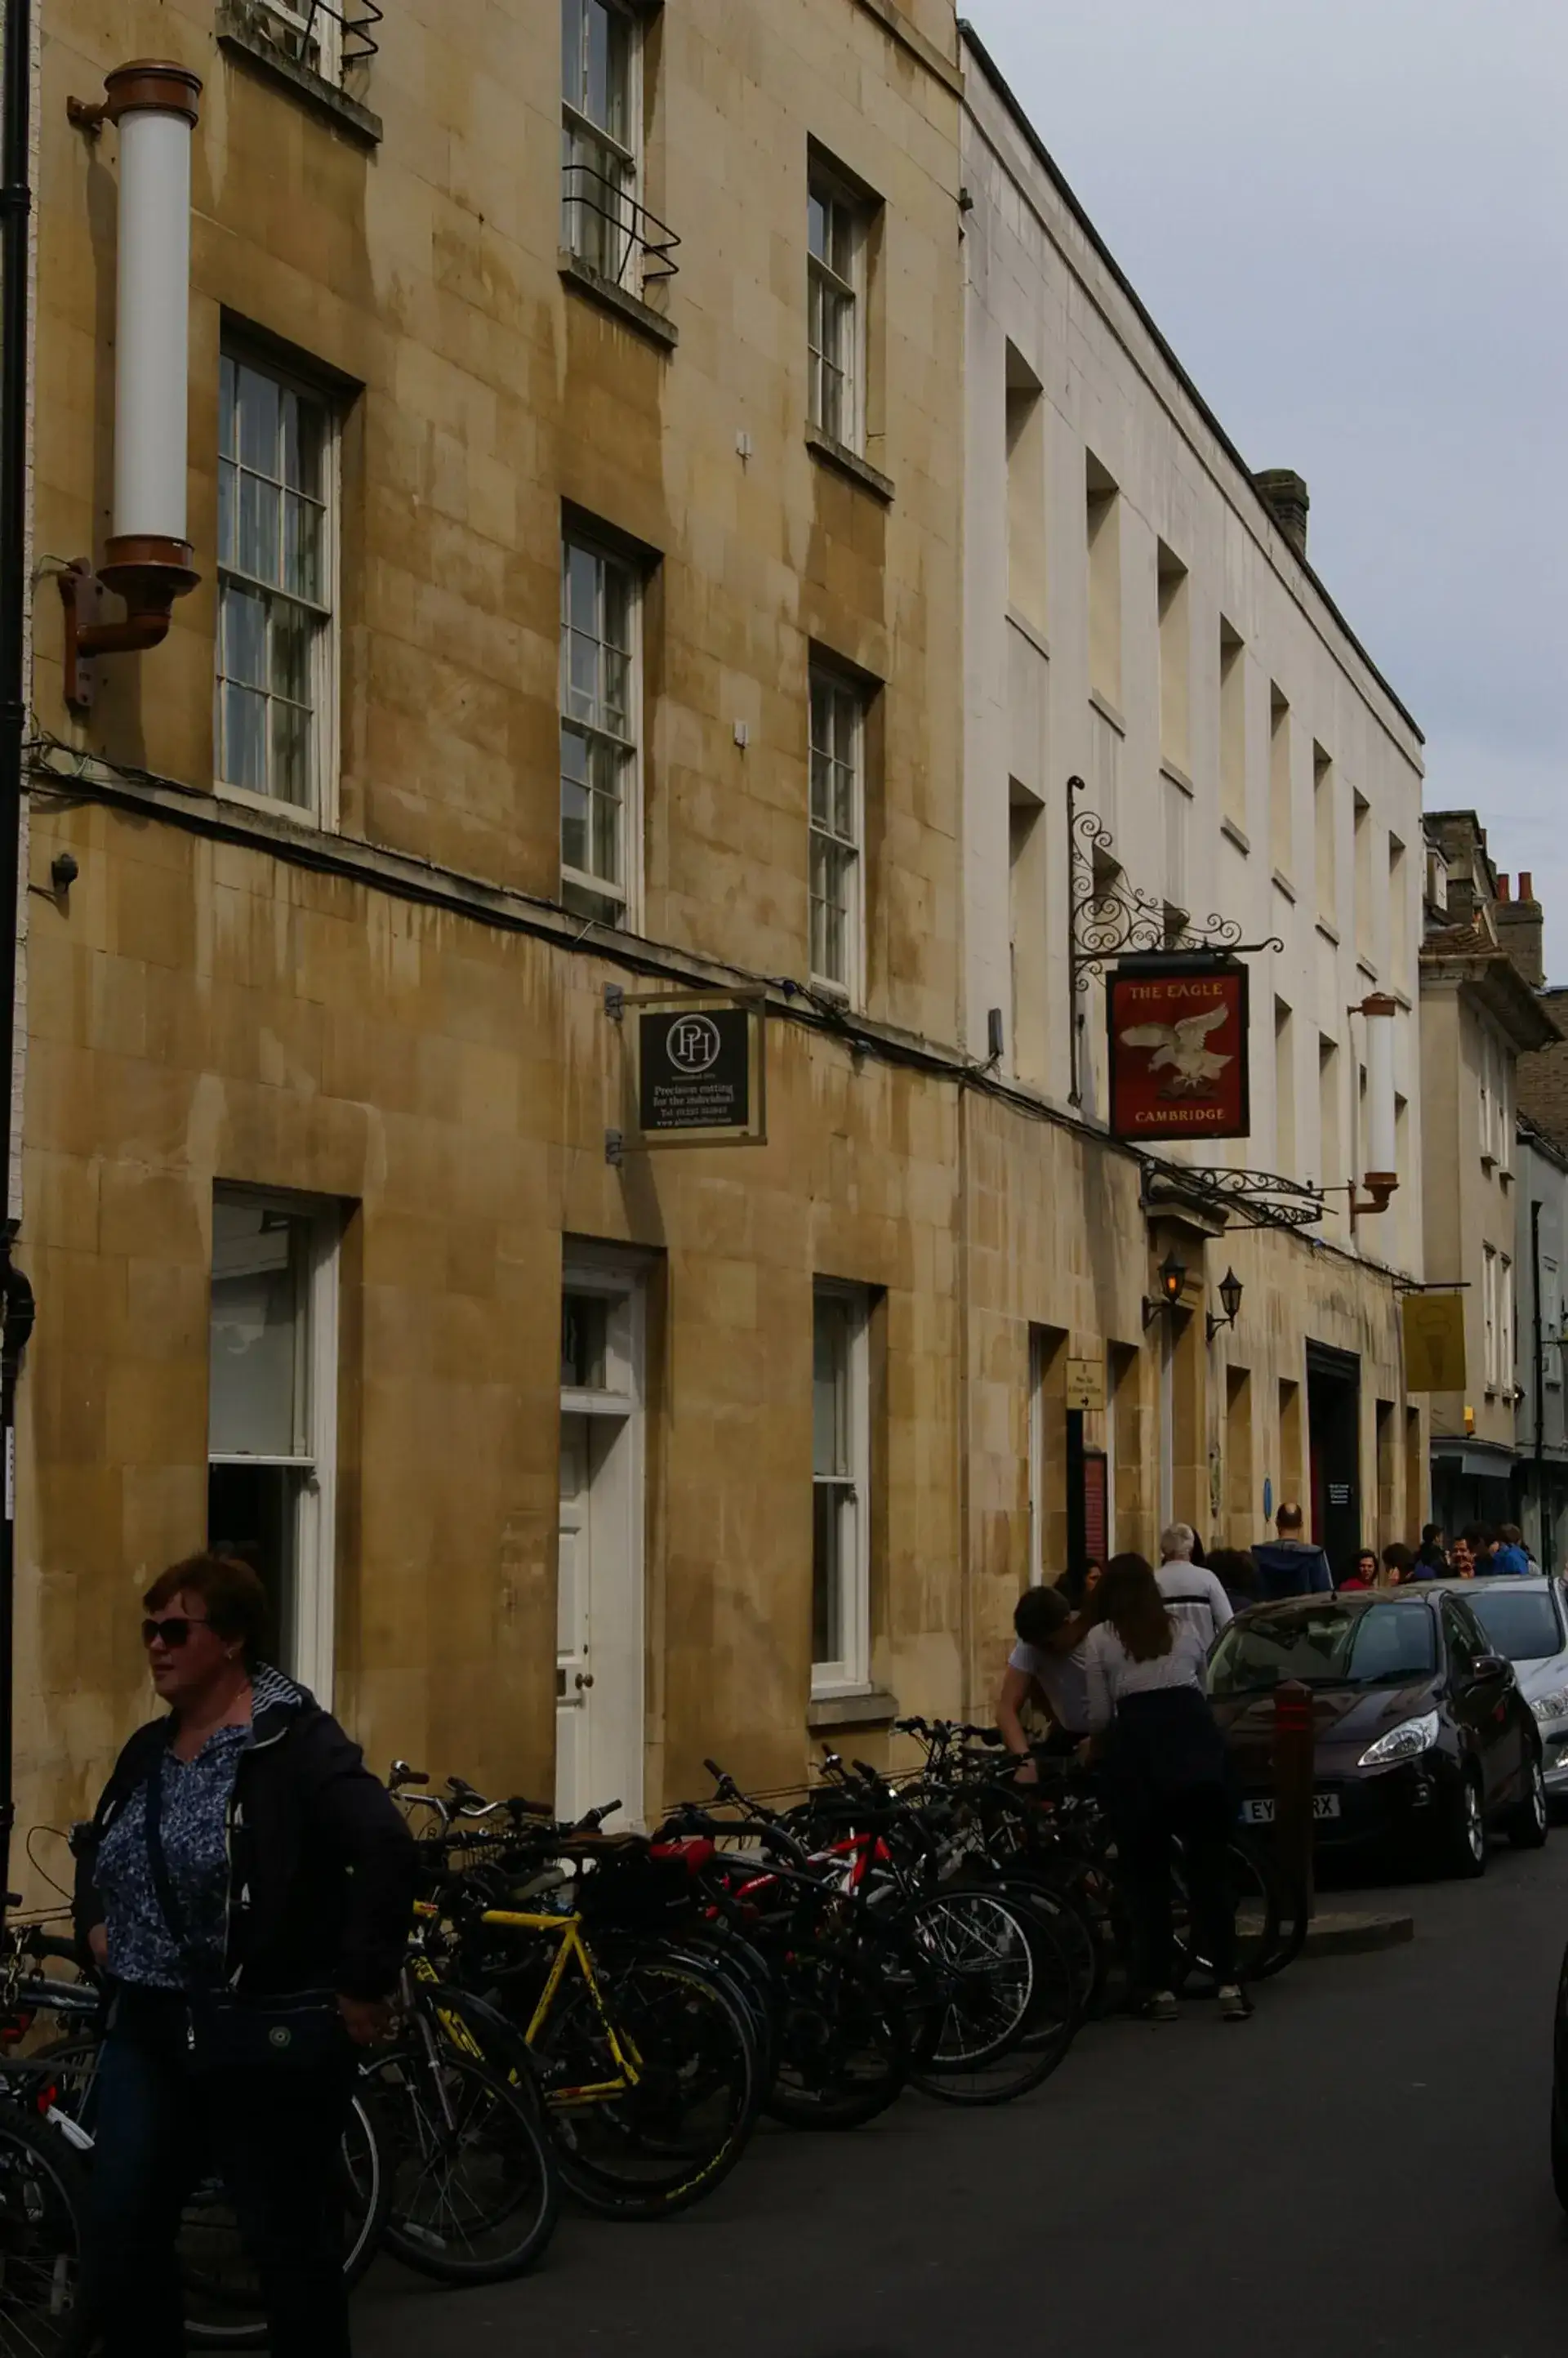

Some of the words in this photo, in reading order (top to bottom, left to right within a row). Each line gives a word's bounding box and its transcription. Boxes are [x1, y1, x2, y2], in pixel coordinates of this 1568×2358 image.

[1129, 986, 1162, 1000] THE
[1167, 983, 1223, 998] EAGLE
[669, 1095, 684, 1105] the
[1135, 1108, 1226, 1123] CAMBRIDGE
